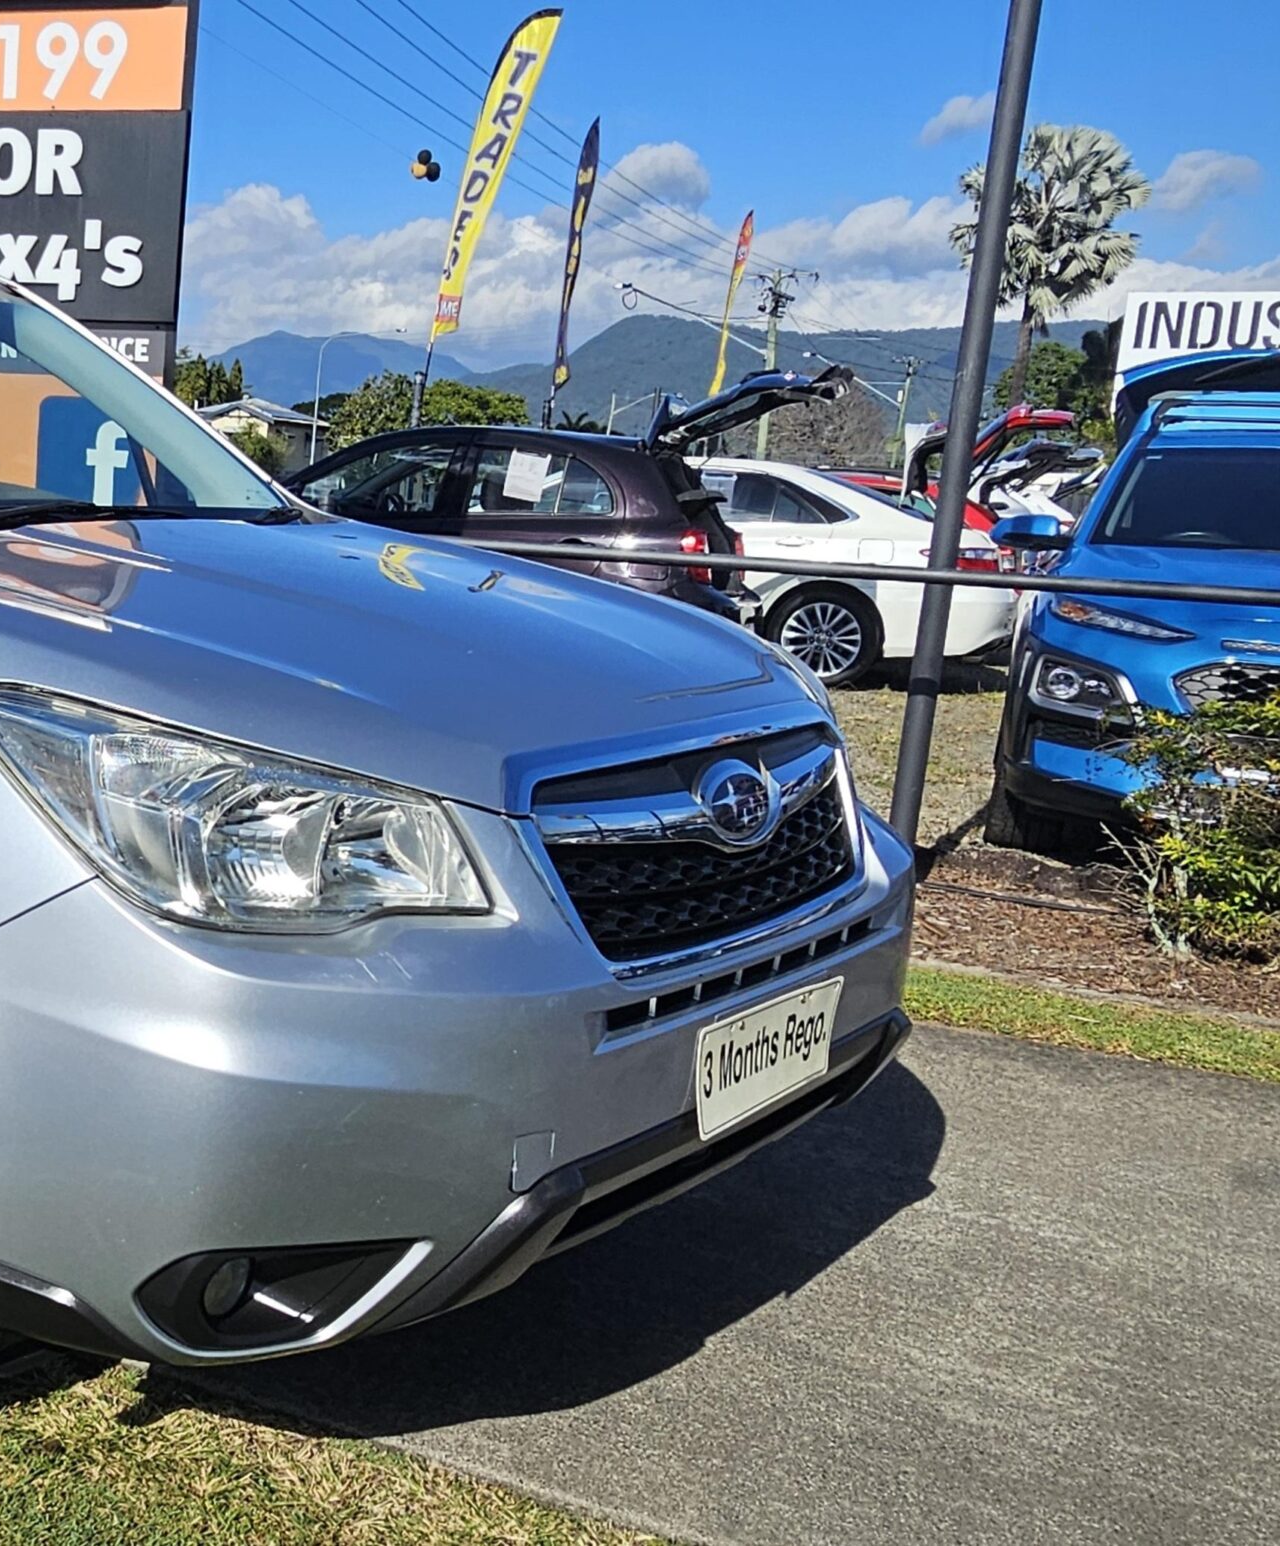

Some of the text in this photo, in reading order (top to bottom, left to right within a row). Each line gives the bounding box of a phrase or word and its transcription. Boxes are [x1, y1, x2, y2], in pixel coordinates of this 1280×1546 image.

[703, 1011, 827, 1099] 3 Months Rego.
